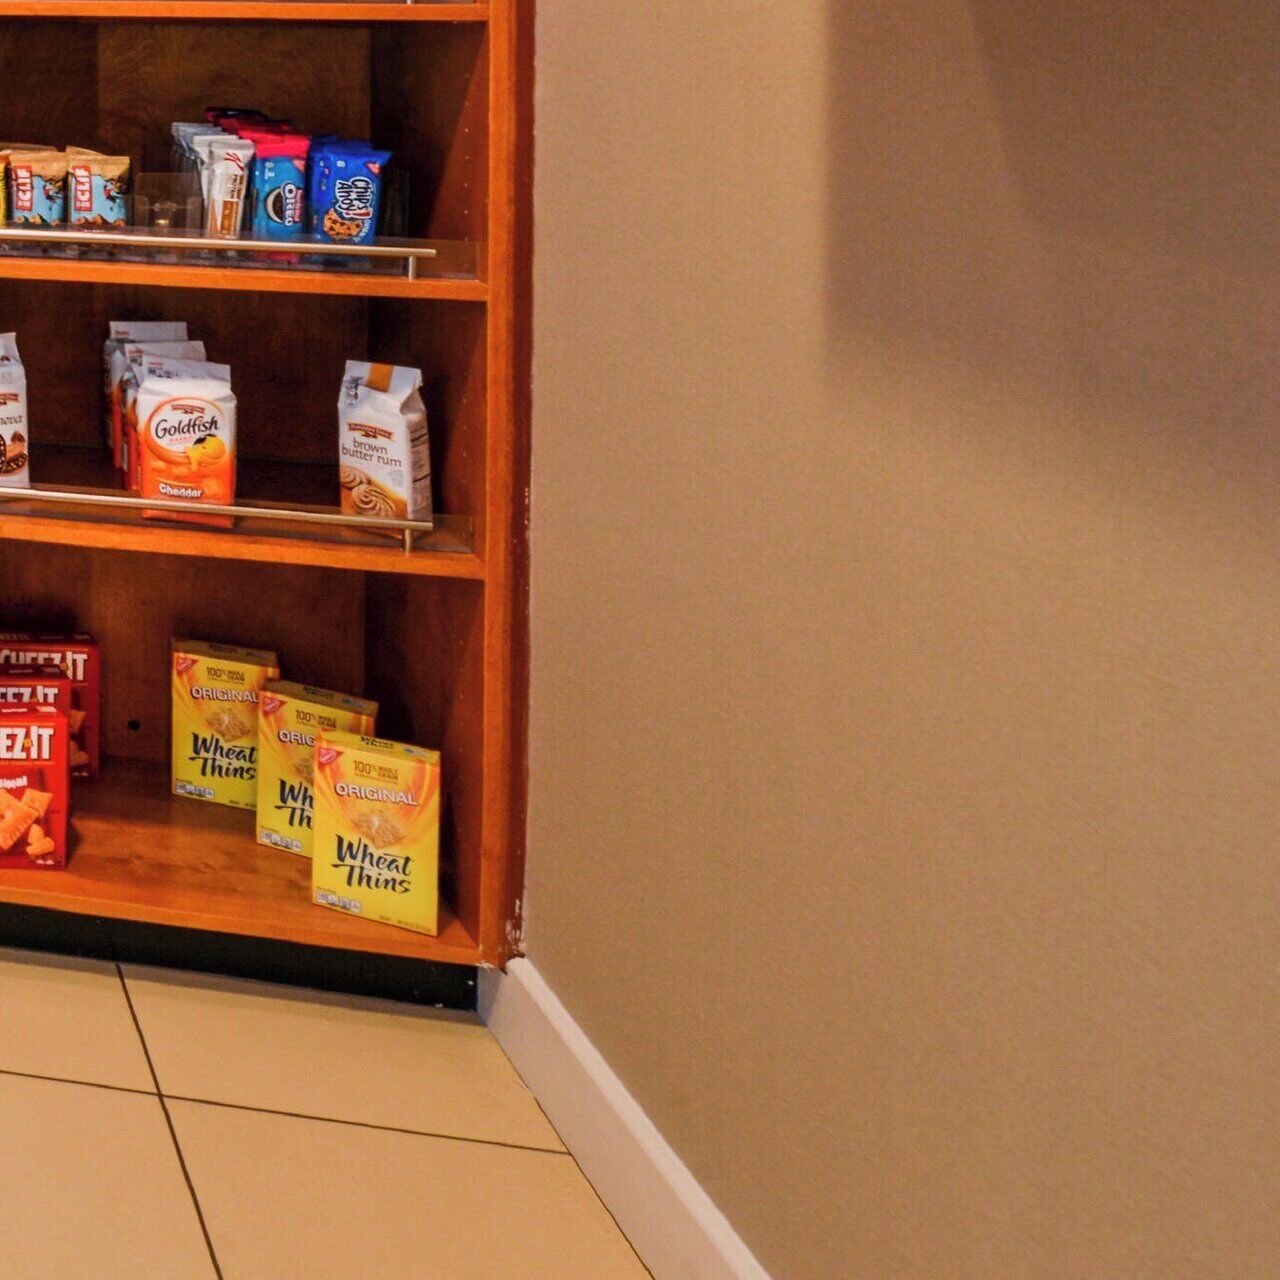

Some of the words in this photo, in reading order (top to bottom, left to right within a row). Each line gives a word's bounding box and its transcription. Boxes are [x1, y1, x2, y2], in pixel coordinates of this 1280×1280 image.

[16, 168, 33, 201] CLIF
[74, 168, 93, 201] CLIF
[351, 178, 372, 212] Chips
[283, 182, 297, 226] OREO
[154, 415, 218, 439] Goldfish
[341, 443, 374, 462] butter
[376, 453, 403, 468] rum
[353, 437, 389, 455] brown
[158, 482, 203, 498] Cheddar
[191, 686, 260, 704] ORIGINAL
[191, 731, 259, 765] Wheat
[188, 756, 258, 781] Thins
[353, 760, 378, 775] 100%
[335, 783, 420, 807] ORIGINAL
[335, 833, 413, 877] Wheat
[330, 864, 412, 895] Thins
